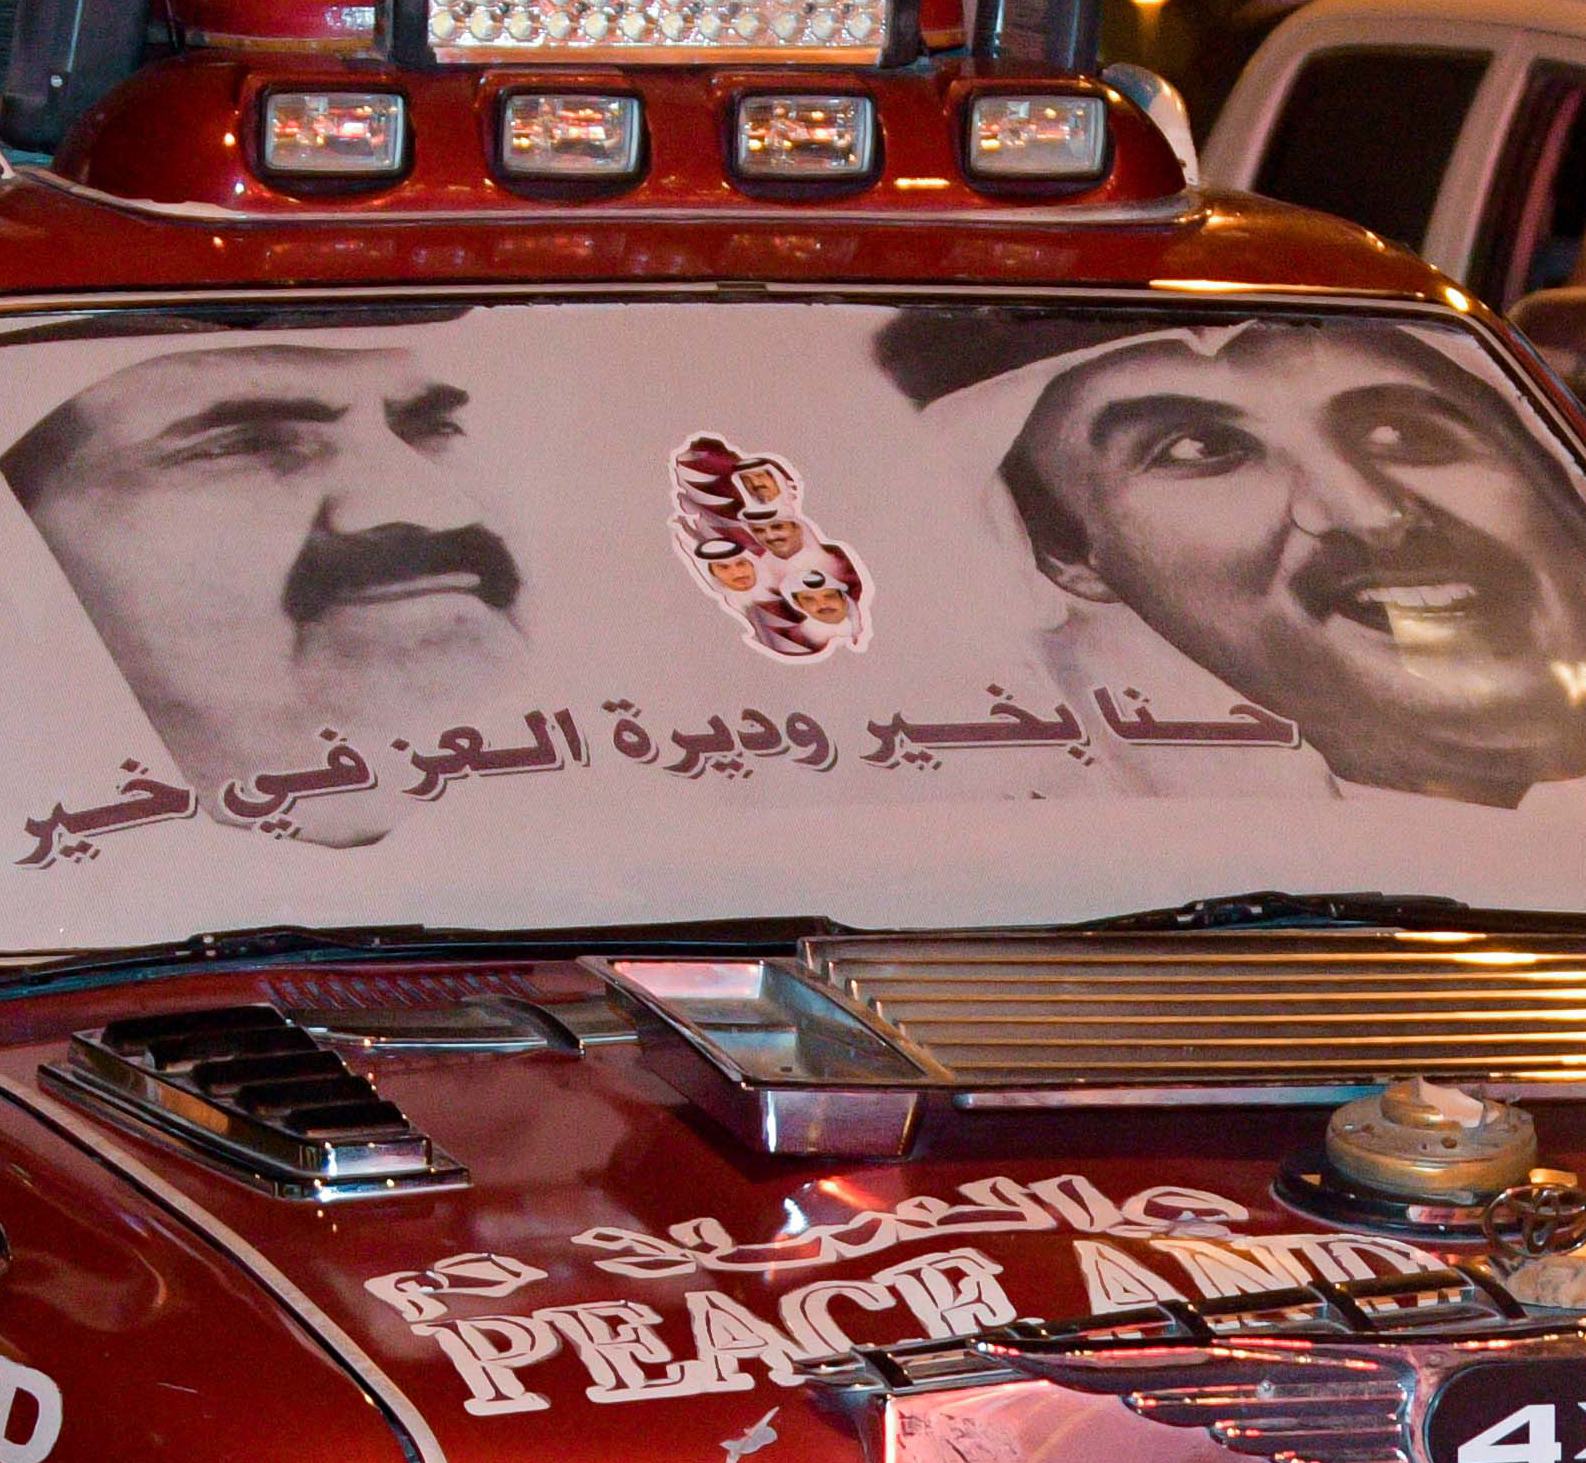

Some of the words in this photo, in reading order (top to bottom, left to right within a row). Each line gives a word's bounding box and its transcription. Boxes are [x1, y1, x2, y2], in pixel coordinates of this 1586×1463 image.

[390, 707, 591, 802] العز
[602, 698, 838, 780] وديرة
[860, 684, 1094, 769] بخير
[1093, 685, 1302, 749] حنا
[13, 757, 198, 869] خير
[221, 727, 379, 840] في
[434, 1244, 1046, 1418] PEACE
